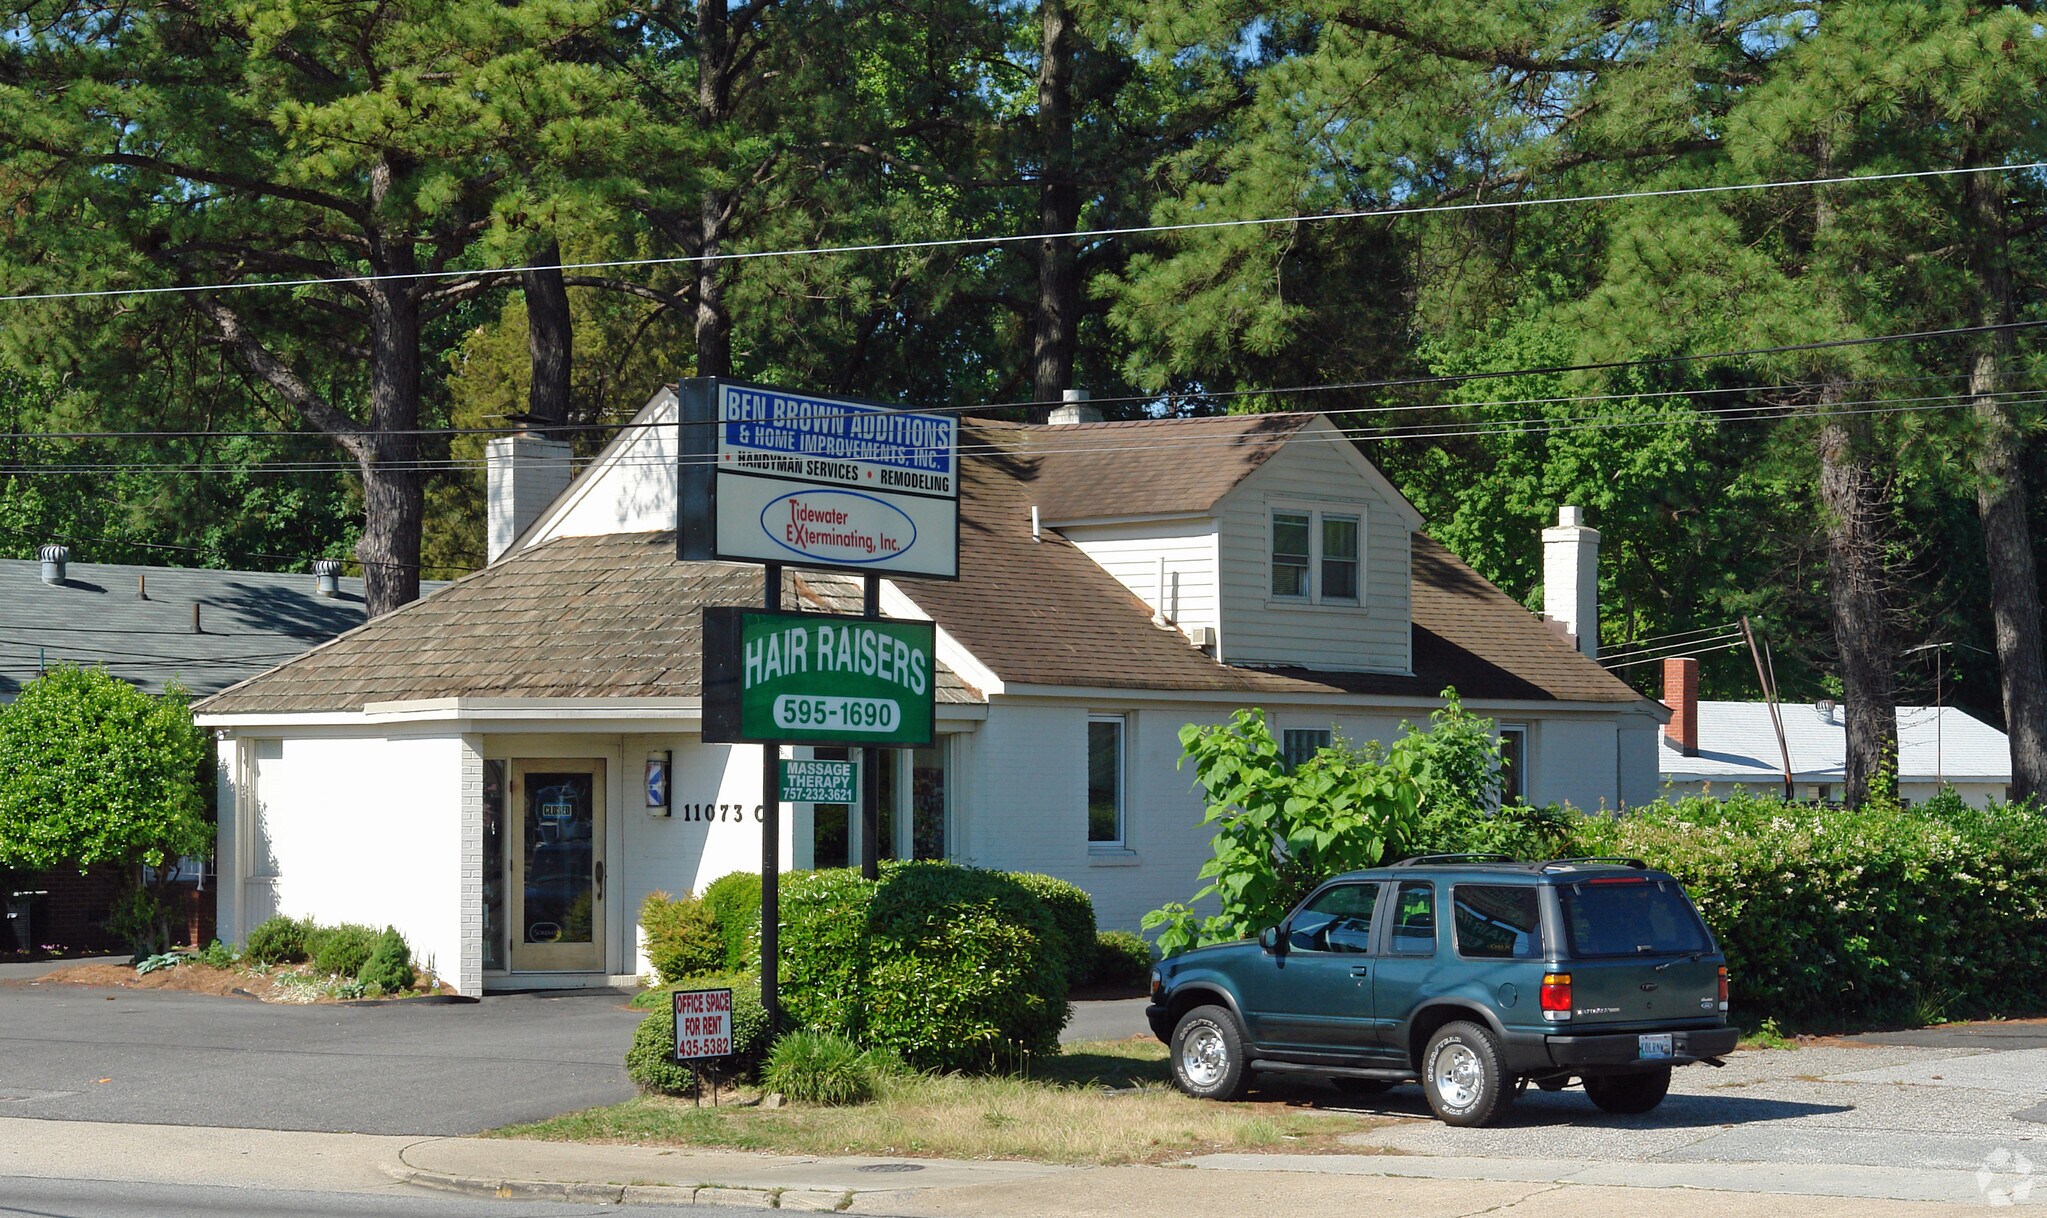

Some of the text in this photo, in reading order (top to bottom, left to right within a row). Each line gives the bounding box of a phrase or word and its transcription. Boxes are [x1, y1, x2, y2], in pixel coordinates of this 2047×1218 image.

[728, 391, 950, 450] BEN BROWN ADDITIONS
[739, 425, 941, 469] & HOME IMPROVEMENTS, INC.
[738, 450, 950, 492] HANDYMAN SERVICES REMODELING
[789, 499, 848, 526] Tidewater
[880, 532, 900, 551] Inc.
[745, 625, 926, 696] HAIR RAISERS
[783, 699, 892, 727] 595-1690
[787, 761, 851, 776] MASSAGE
[788, 775, 851, 789] THERAPY
[783, 787, 852, 801] 757-232-3621
[544, 805, 570, 815] CLOSED
[684, 803, 743, 823] 11073
[677, 993, 729, 1014] OFFICE SPACE
[685, 1016, 722, 1036] FOR RENT
[679, 1037, 729, 1056] 435-5382
